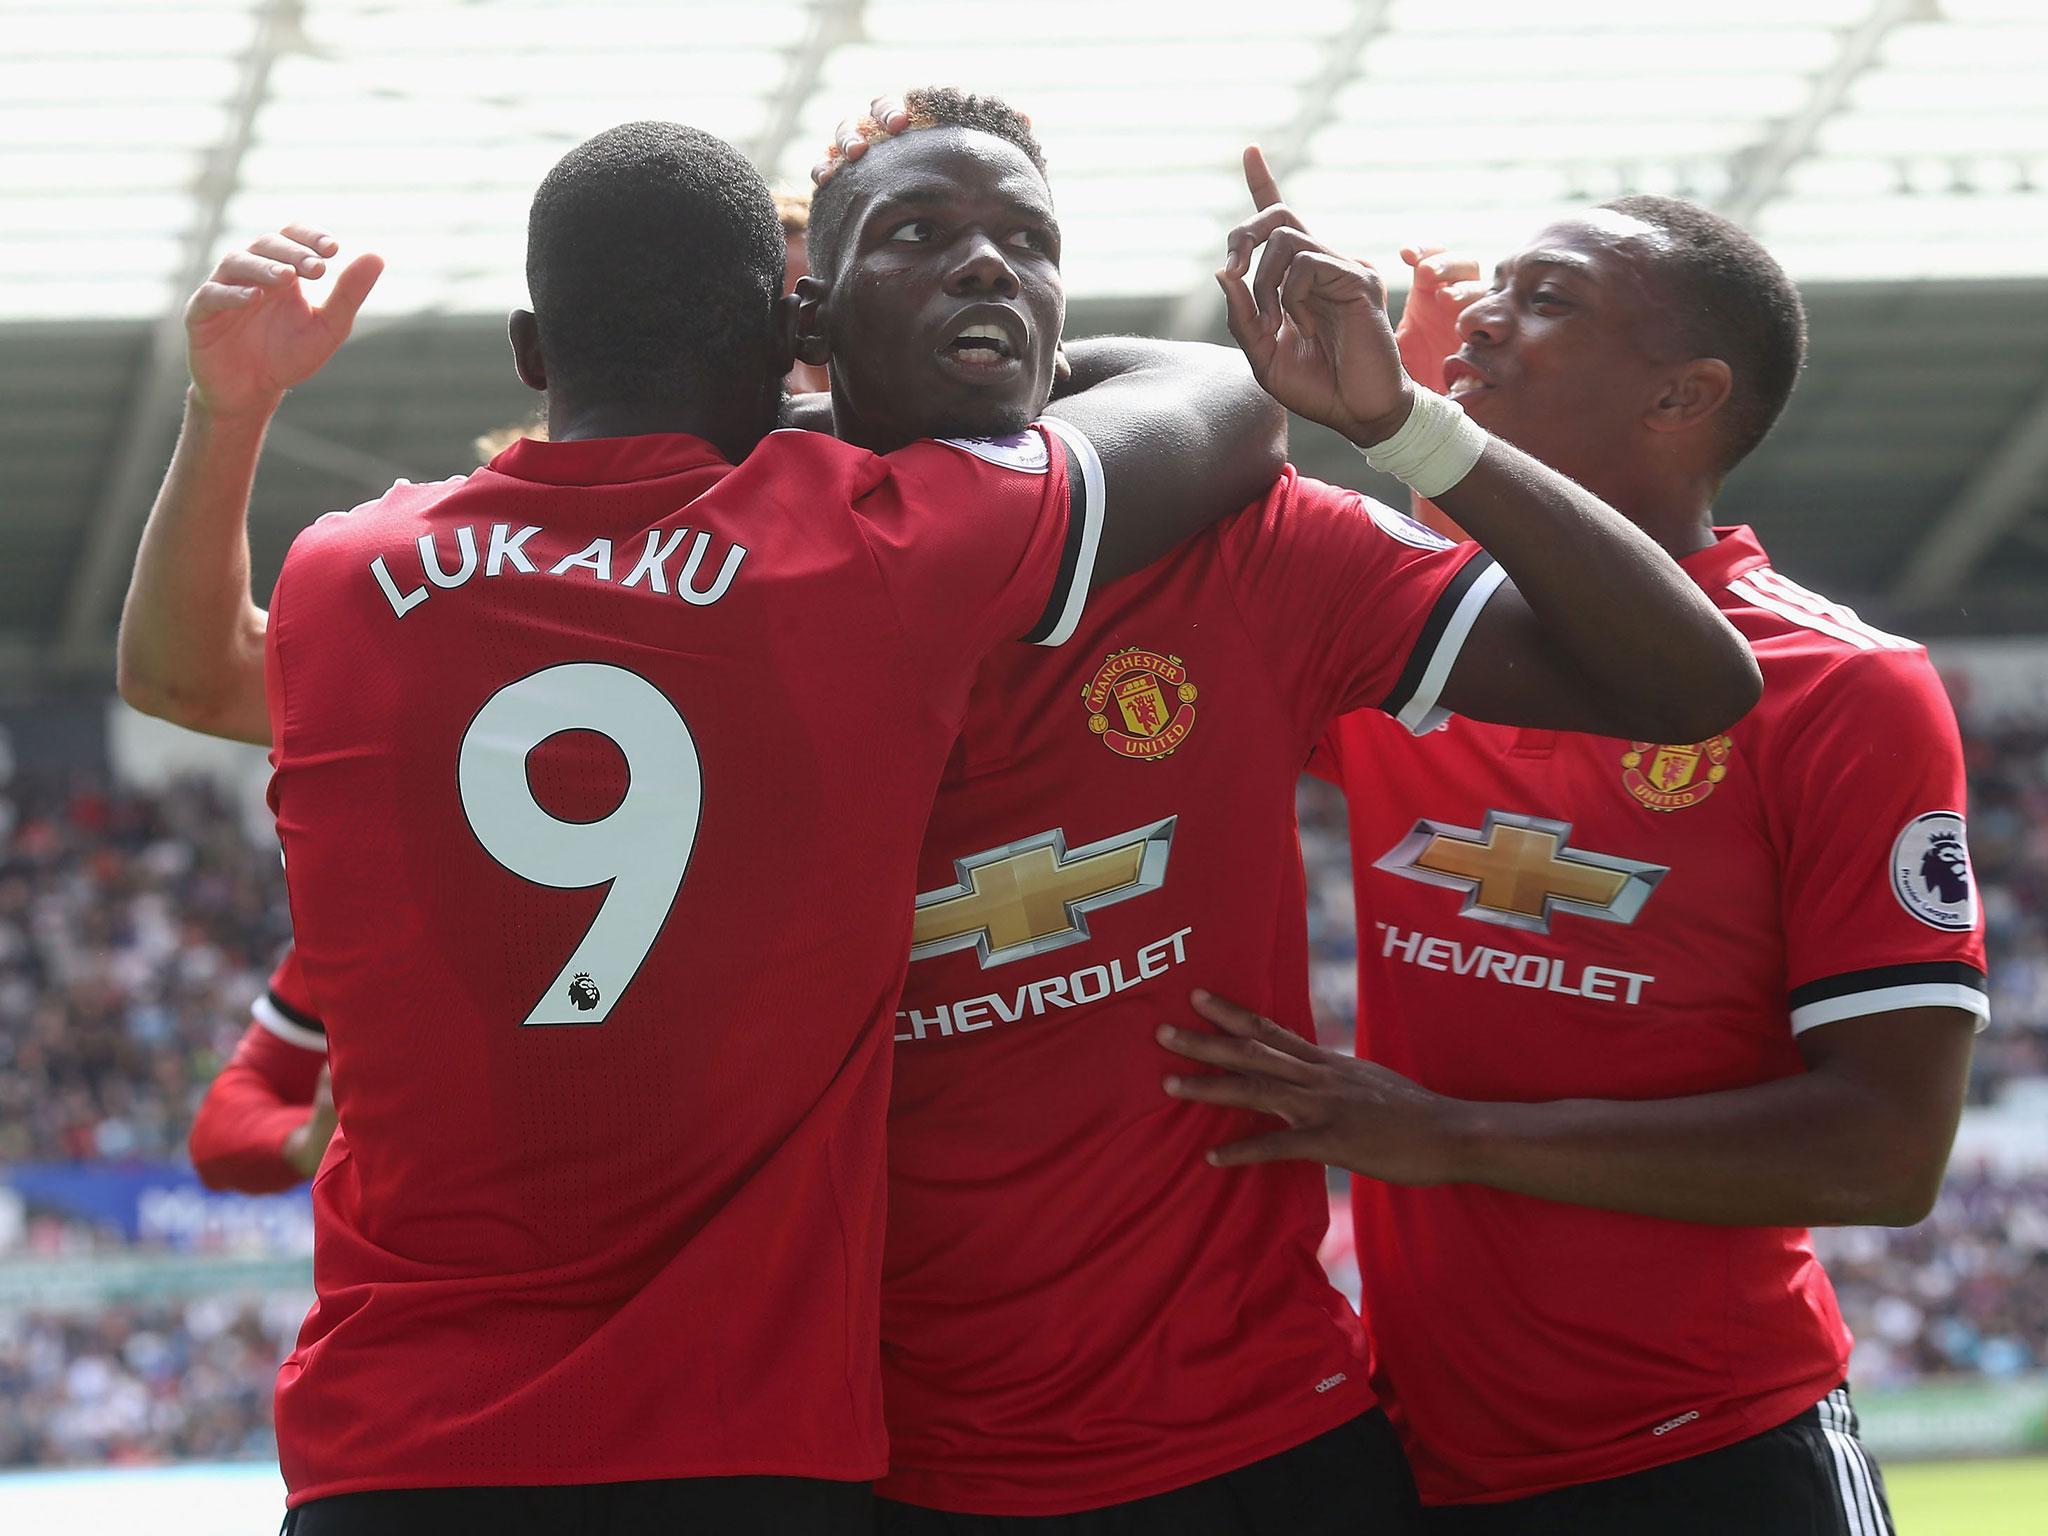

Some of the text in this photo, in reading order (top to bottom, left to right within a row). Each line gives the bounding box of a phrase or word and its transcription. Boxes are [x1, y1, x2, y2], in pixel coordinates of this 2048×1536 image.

[369, 523, 749, 621] LUKAKU
[1091, 655, 1177, 704] MANCHESTER
[1125, 724, 1185, 754] UNITED
[1634, 784, 1694, 805] UNITED
[456, 661, 704, 1028] 9
[1375, 922, 1656, 1005] HEVROLET
[1652, 1410, 1700, 1436] adizero
